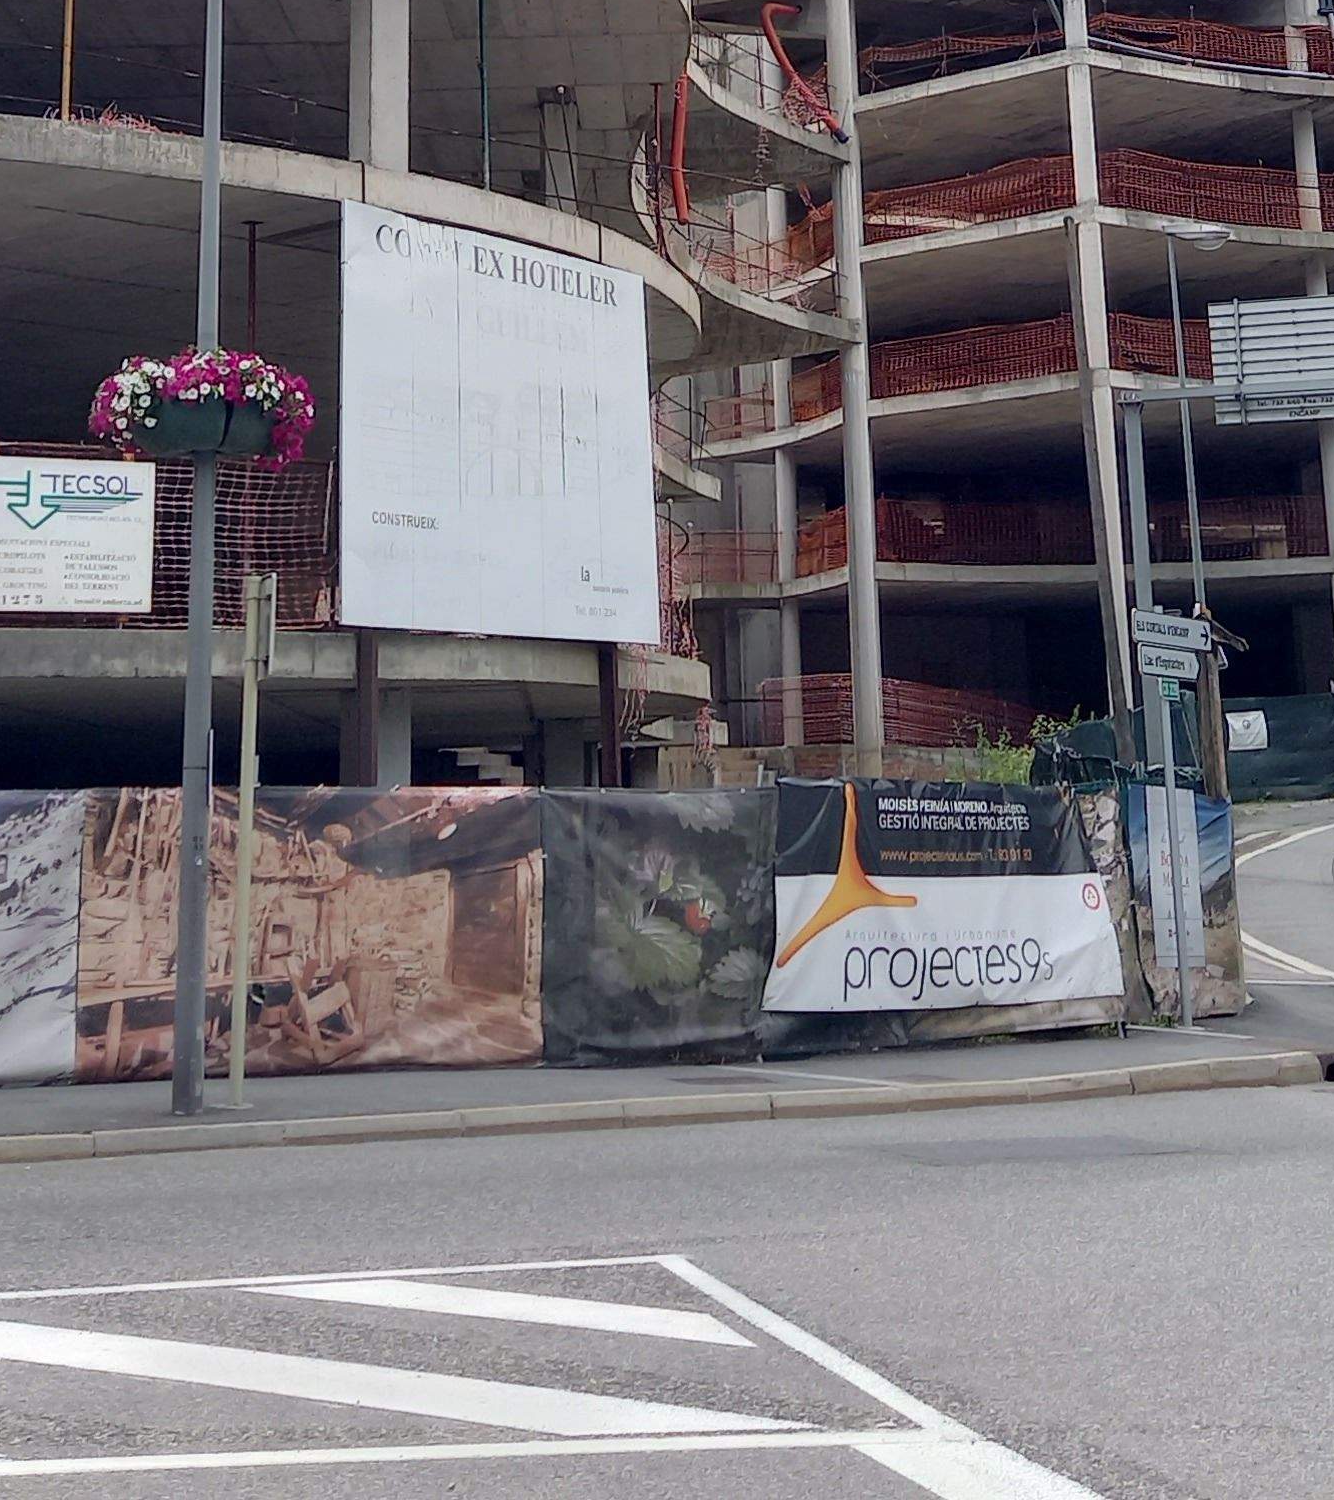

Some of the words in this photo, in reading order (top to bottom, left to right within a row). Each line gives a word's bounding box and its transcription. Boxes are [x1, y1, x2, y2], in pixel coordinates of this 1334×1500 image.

[511, 254, 617, 308] HOTELER
[1289, 408, 1321, 418] ENCAMP
[40, 474, 144, 496] TECSOL
[878, 812, 920, 830] GESTIÓ
[921, 815, 965, 831] INTEGRAL
[965, 816, 977, 831] DE
[978, 816, 1030, 831] PROJECTES
